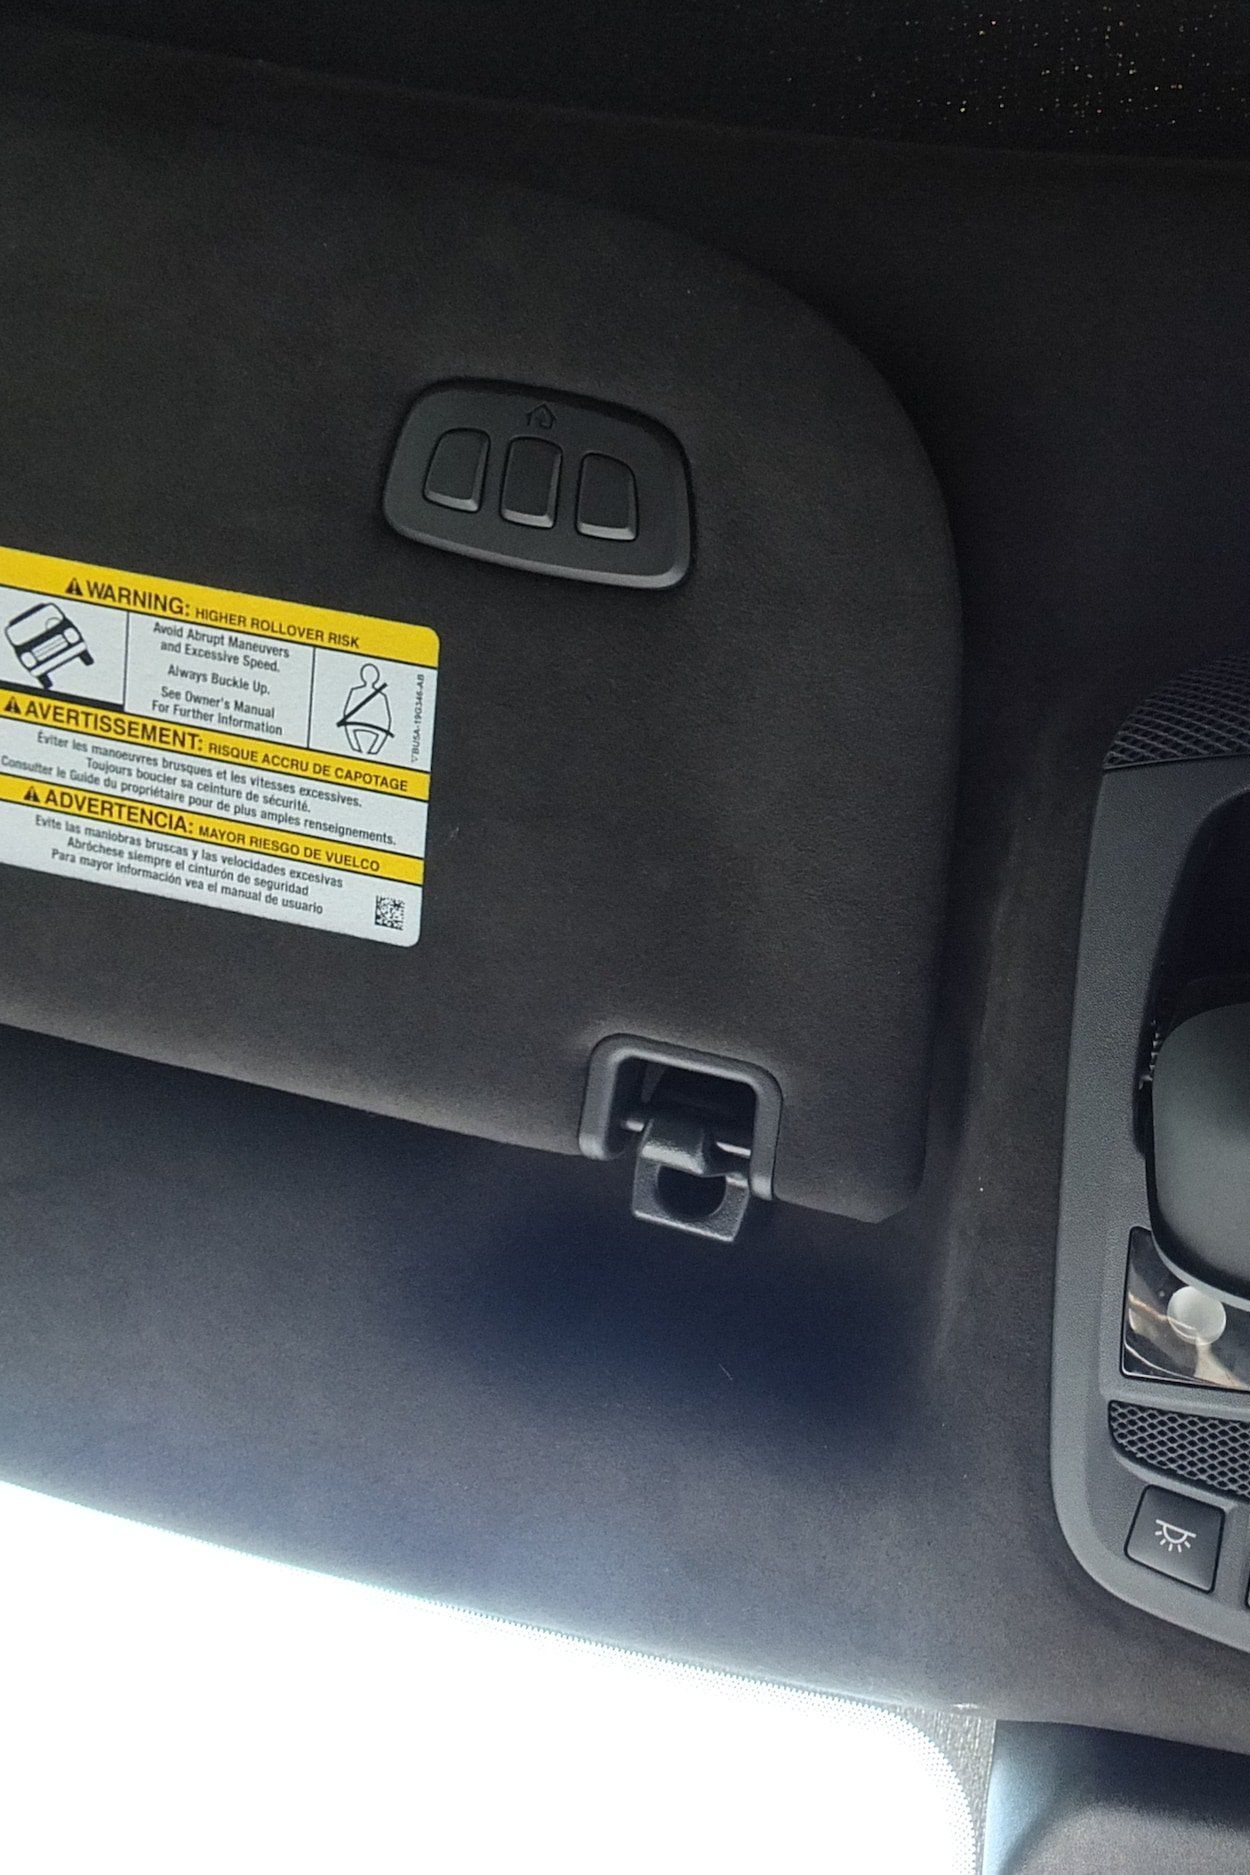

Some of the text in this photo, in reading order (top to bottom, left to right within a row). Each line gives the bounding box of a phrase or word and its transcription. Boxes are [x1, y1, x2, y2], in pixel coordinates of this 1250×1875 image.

[86, 580, 359, 649] WARNING: HIGHER ROLLOVER RISK
[152, 621, 290, 658] Avoid Abrupt Maneuvers
[160, 641, 280, 672] and Excessive Speed.
[167, 664, 270, 696] Always Buckle Up.
[151, 699, 282, 736] For Further Information
[161, 685, 275, 719] See Owner's Manual
[24, 701, 408, 792] AVERTISSEMENT: RISQUE ACCRU DE CAPOTAGE
[37, 730, 362, 807] Éviter les manoeuvres brusques et les vitesses excessives.
[56, 766, 66, 779] le
[69, 769, 100, 785] Guide
[103, 776, 117, 789] du
[120, 781, 185, 803] propriétaire
[188, 795, 213, 808] pour
[216, 799, 230, 812] de
[233, 803, 257, 818] plus
[260, 810, 301, 826] amples
[303, 818, 396, 845] renseignements.
[86, 756, 311, 813] Toujours boucler sa ceinture de sécurité.
[35, 814, 343, 888] Evite las maniobras bruscas y las velocidades excesivas
[44, 788, 380, 872] ADVERTENCIA: MAYOR RIESGO DE VUELCO
[51, 848, 323, 915] Para mayor información vea el manual de usuario
[67, 836, 309, 896] Abróchese siempre el cinturón de seguridad
